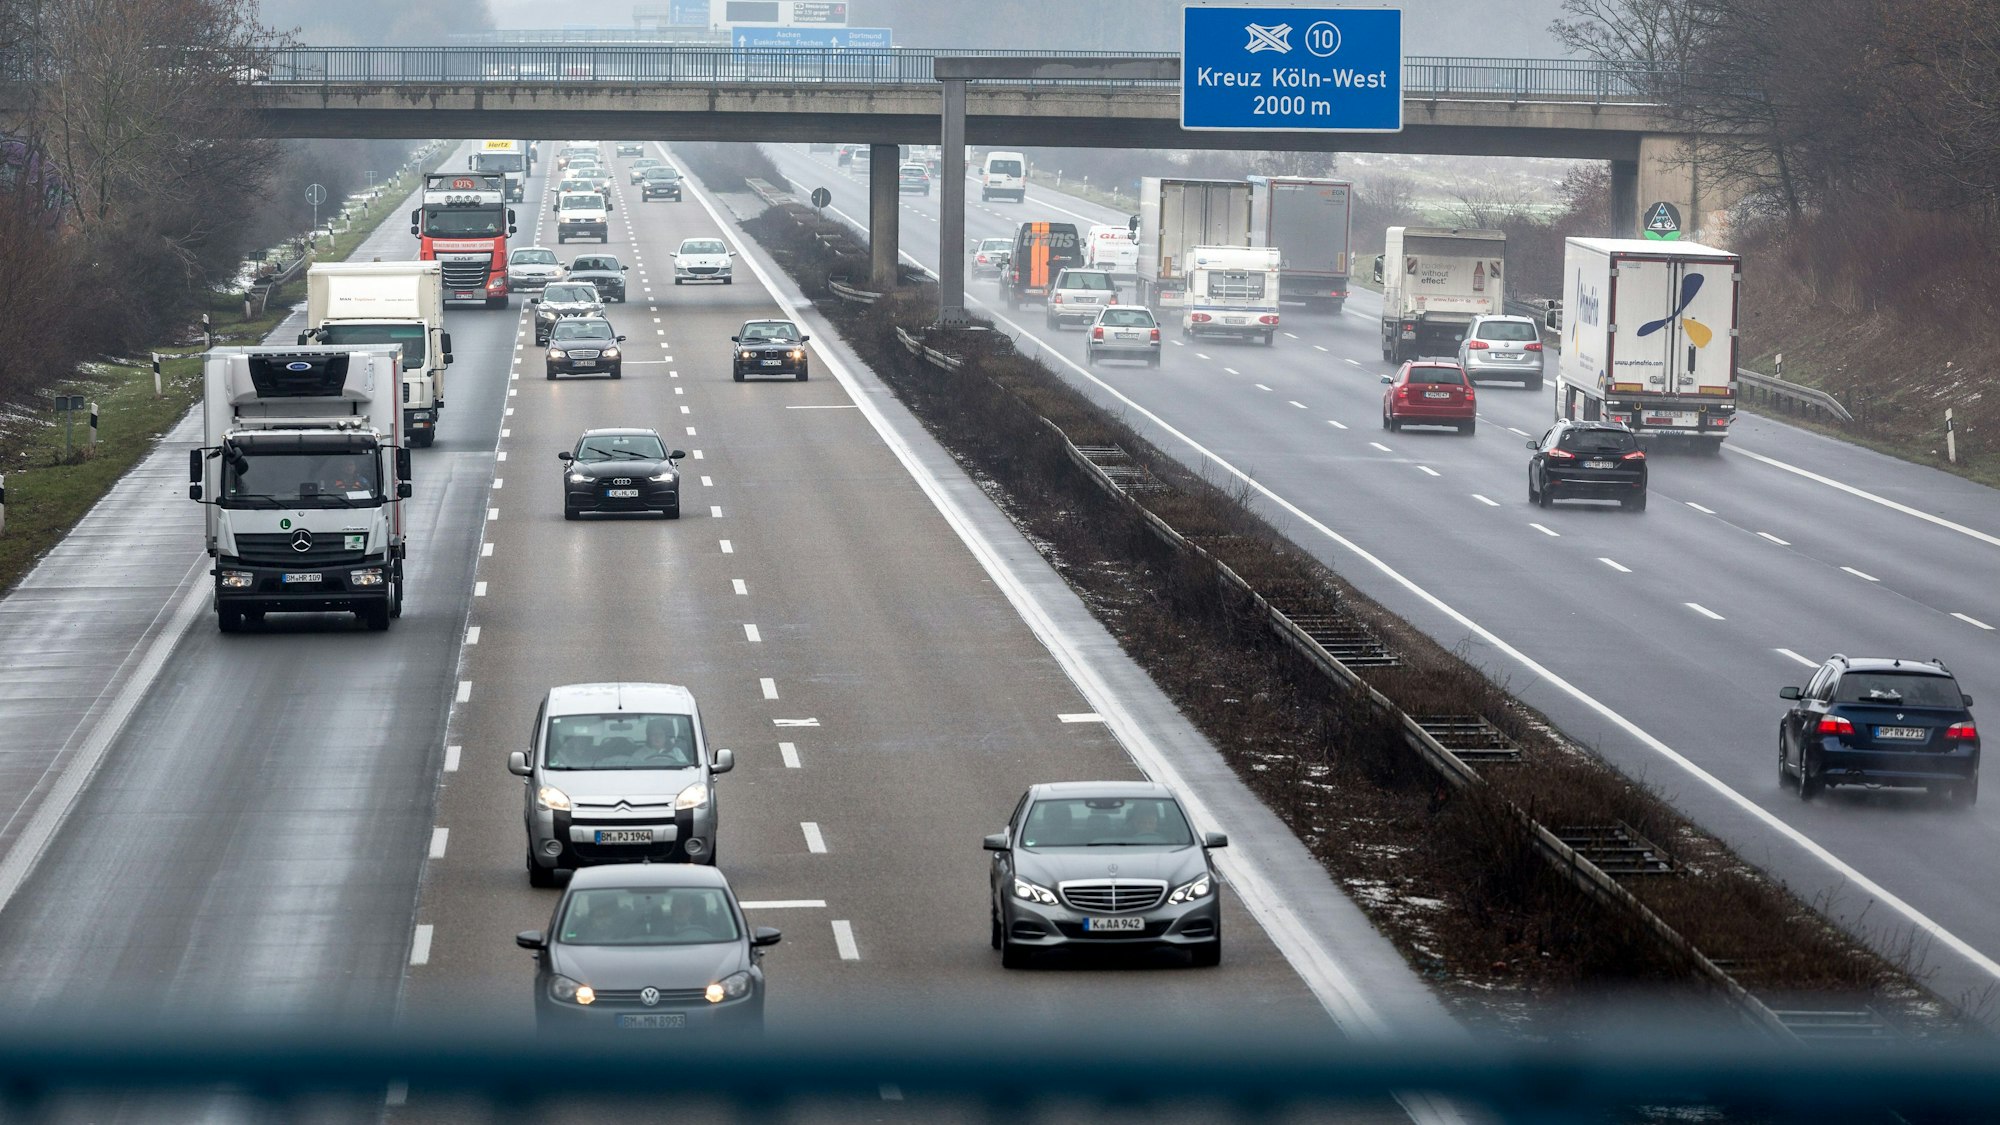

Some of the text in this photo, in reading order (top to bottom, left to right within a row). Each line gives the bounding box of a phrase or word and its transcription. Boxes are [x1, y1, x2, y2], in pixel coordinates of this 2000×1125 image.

[848, 39, 885, 47] Düsseldorf
[1312, 29, 1334, 49] 10
[1197, 67, 1387, 88] Kreuz Köln-West
[1253, 95, 1331, 115] 2000 m
[1906, 728, 1924, 737] 2712
[631, 831, 651, 841] 1964
[1121, 919, 1140, 928] 942
